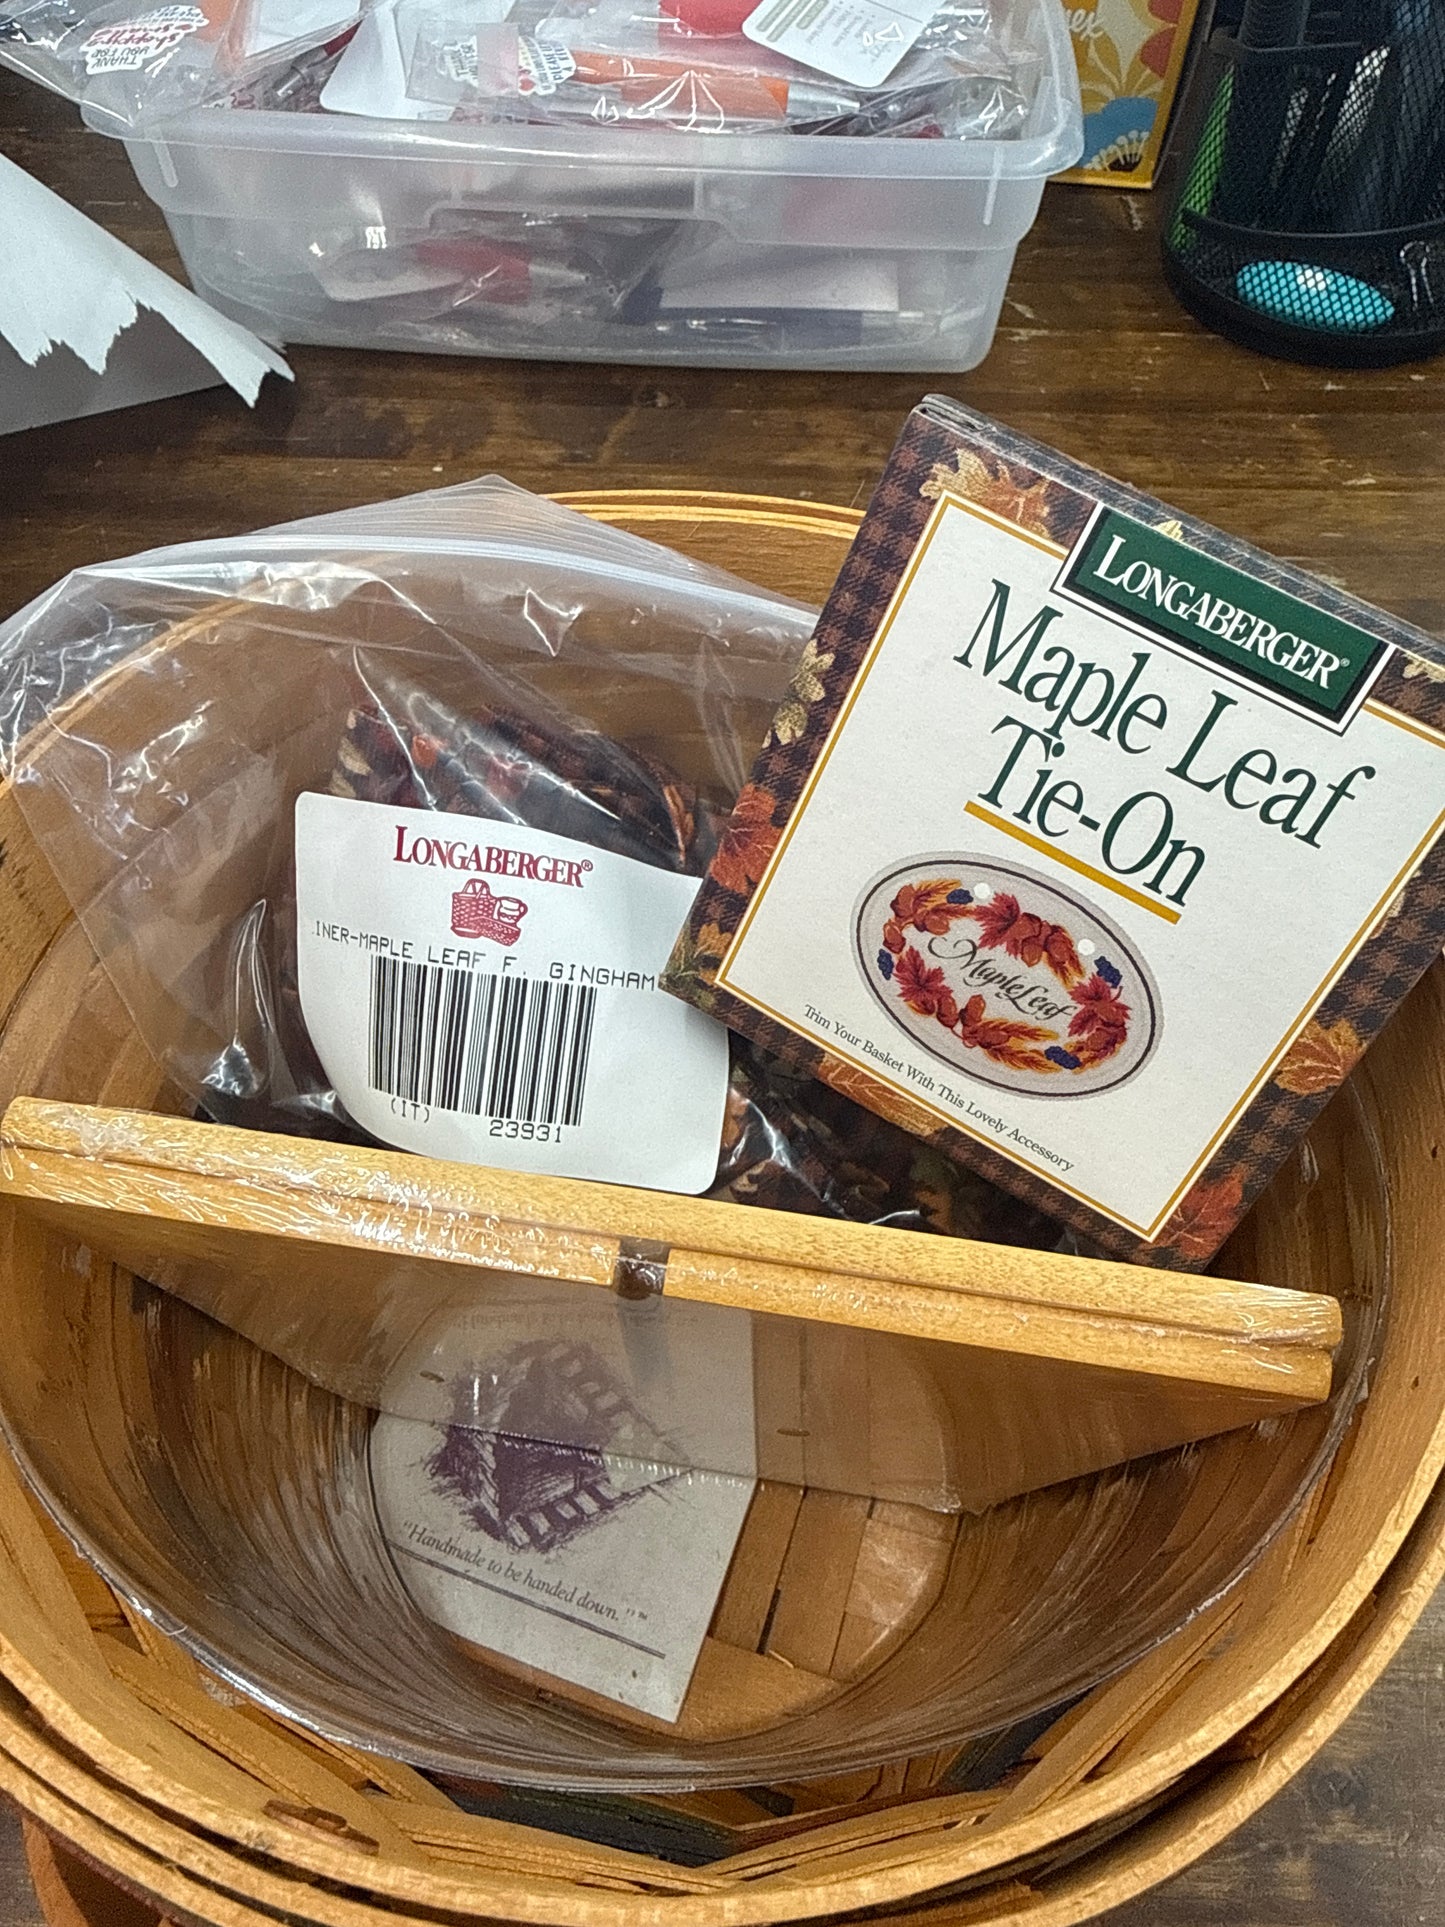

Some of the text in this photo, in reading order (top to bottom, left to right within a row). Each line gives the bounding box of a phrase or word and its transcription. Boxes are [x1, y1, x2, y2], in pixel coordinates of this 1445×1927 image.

[91, 46, 150, 58] YOU FOR
[91, 55, 138, 69] THANK
[953, 579, 1376, 849] Maple Leaf
[978, 715, 1206, 907] Tie-On
[427, 945, 487, 970] LEAF
[503, 956, 527, 976] F.
[549, 961, 656, 992] GINGHAM
[928, 937, 1078, 1021] Maple Leaf
[390, 1099, 432, 1123] (IT)
[804, 1004, 1075, 1172] Trim Your Basket With This Lovely Accessory
[489, 1119, 563, 1144] 23931
[487, 1559, 503, 1576] to
[504, 1561, 523, 1582] be
[522, 1569, 577, 1604] handed
